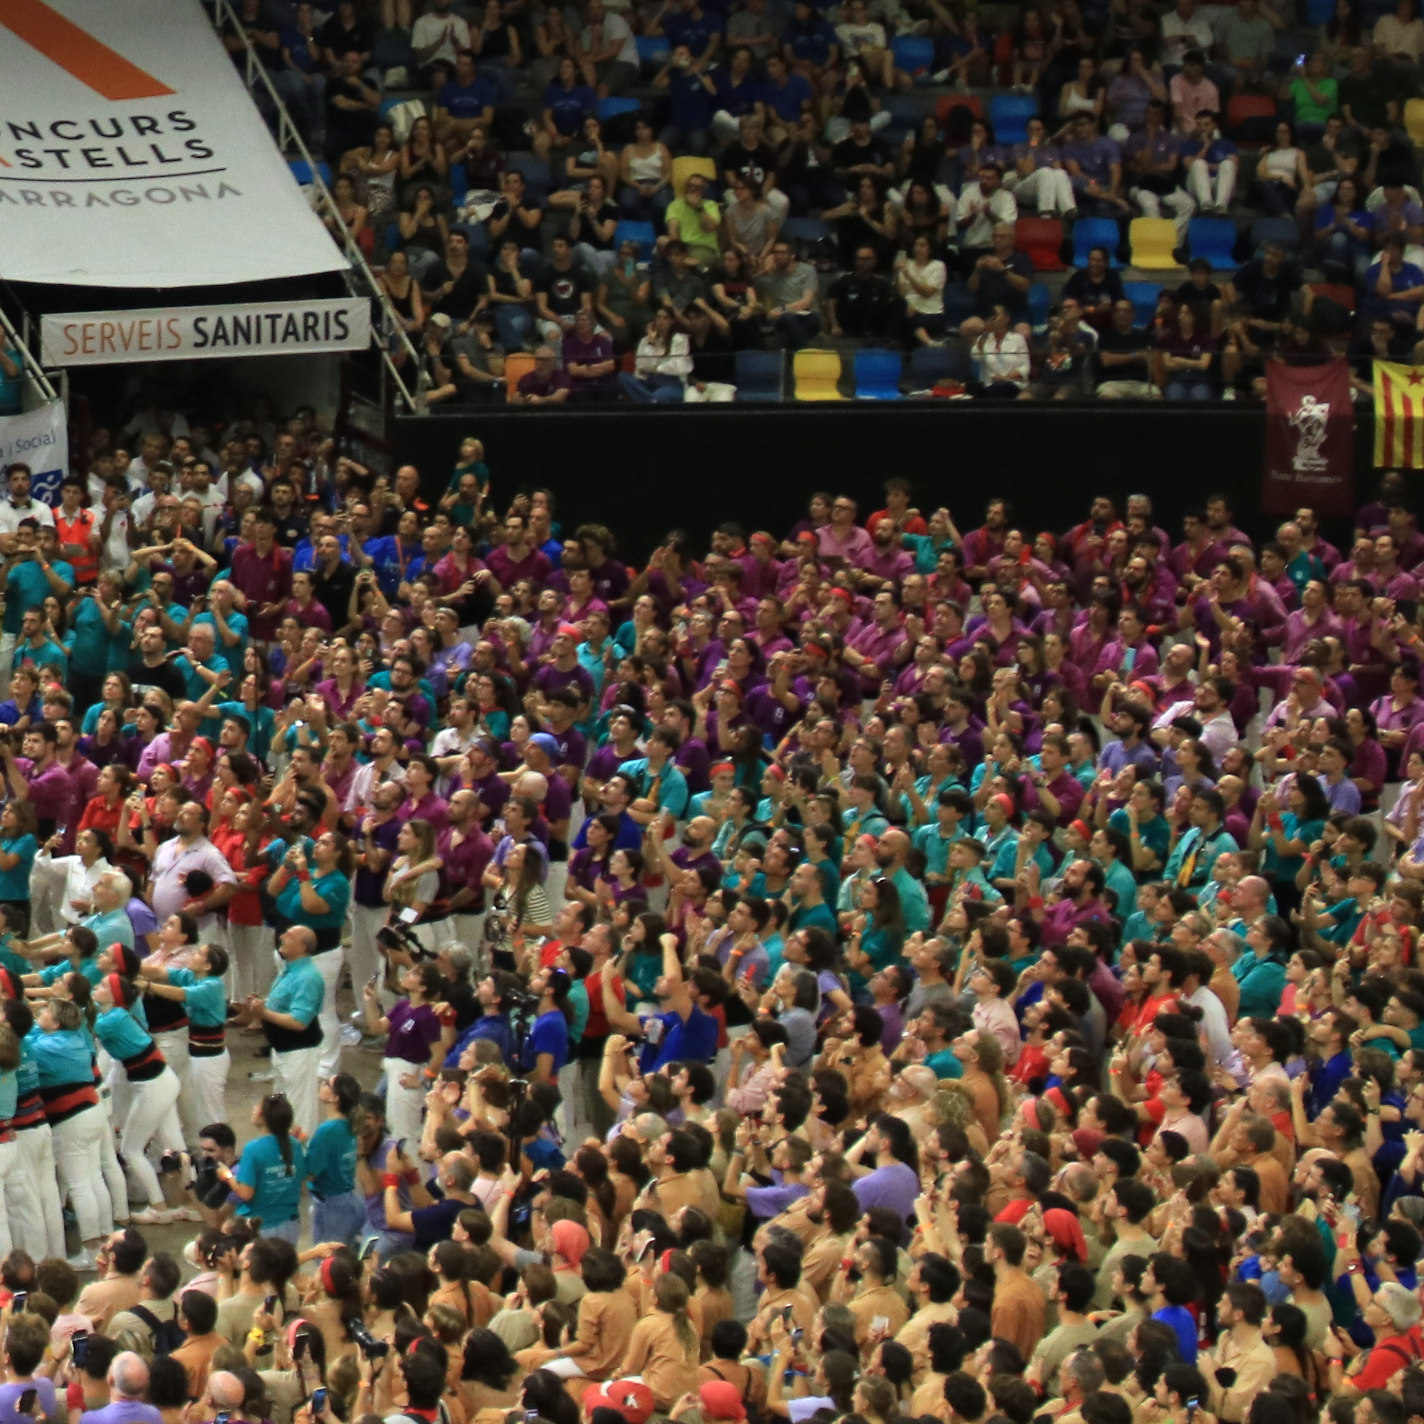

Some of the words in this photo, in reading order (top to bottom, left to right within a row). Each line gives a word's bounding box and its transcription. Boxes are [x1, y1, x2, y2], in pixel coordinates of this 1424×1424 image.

[62, 316, 183, 357] SERVEIS
[192, 308, 350, 350] SANITARIS
[15, 429, 57, 454] Social
